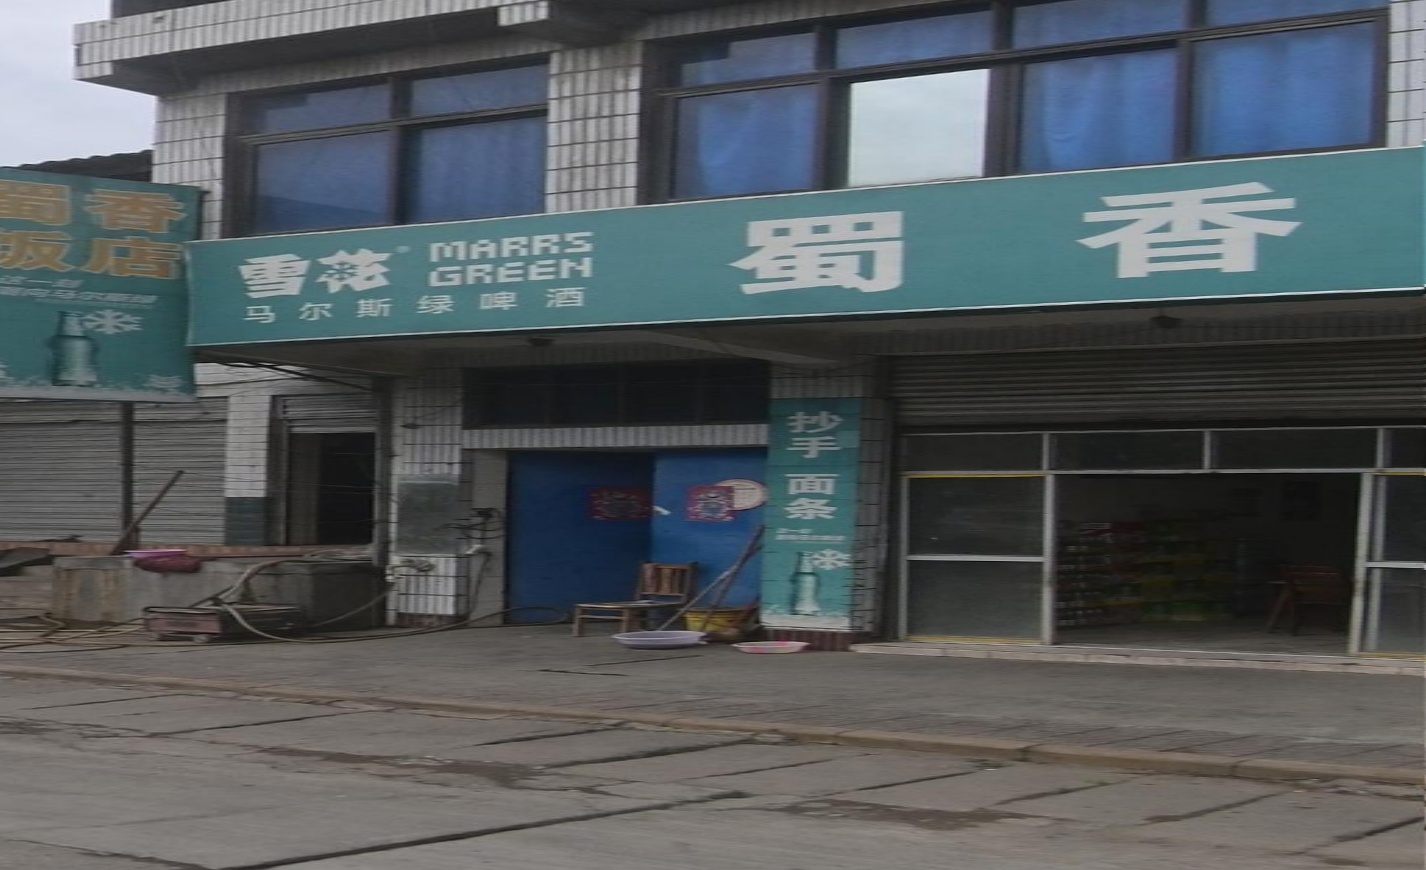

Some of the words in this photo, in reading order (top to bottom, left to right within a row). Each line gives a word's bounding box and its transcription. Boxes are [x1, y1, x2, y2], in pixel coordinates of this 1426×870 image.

[0, 179, 187, 233] 蜀香
[0, 230, 184, 280] 饭店
[429, 231, 594, 263] MARRS
[238, 249, 392, 299] 雪花
[428, 257, 594, 288] GREEN
[243, 286, 587, 324] 马尔斯绿啤酒
[786, 410, 843, 459] 抄手
[784, 473, 840, 520] 面条
